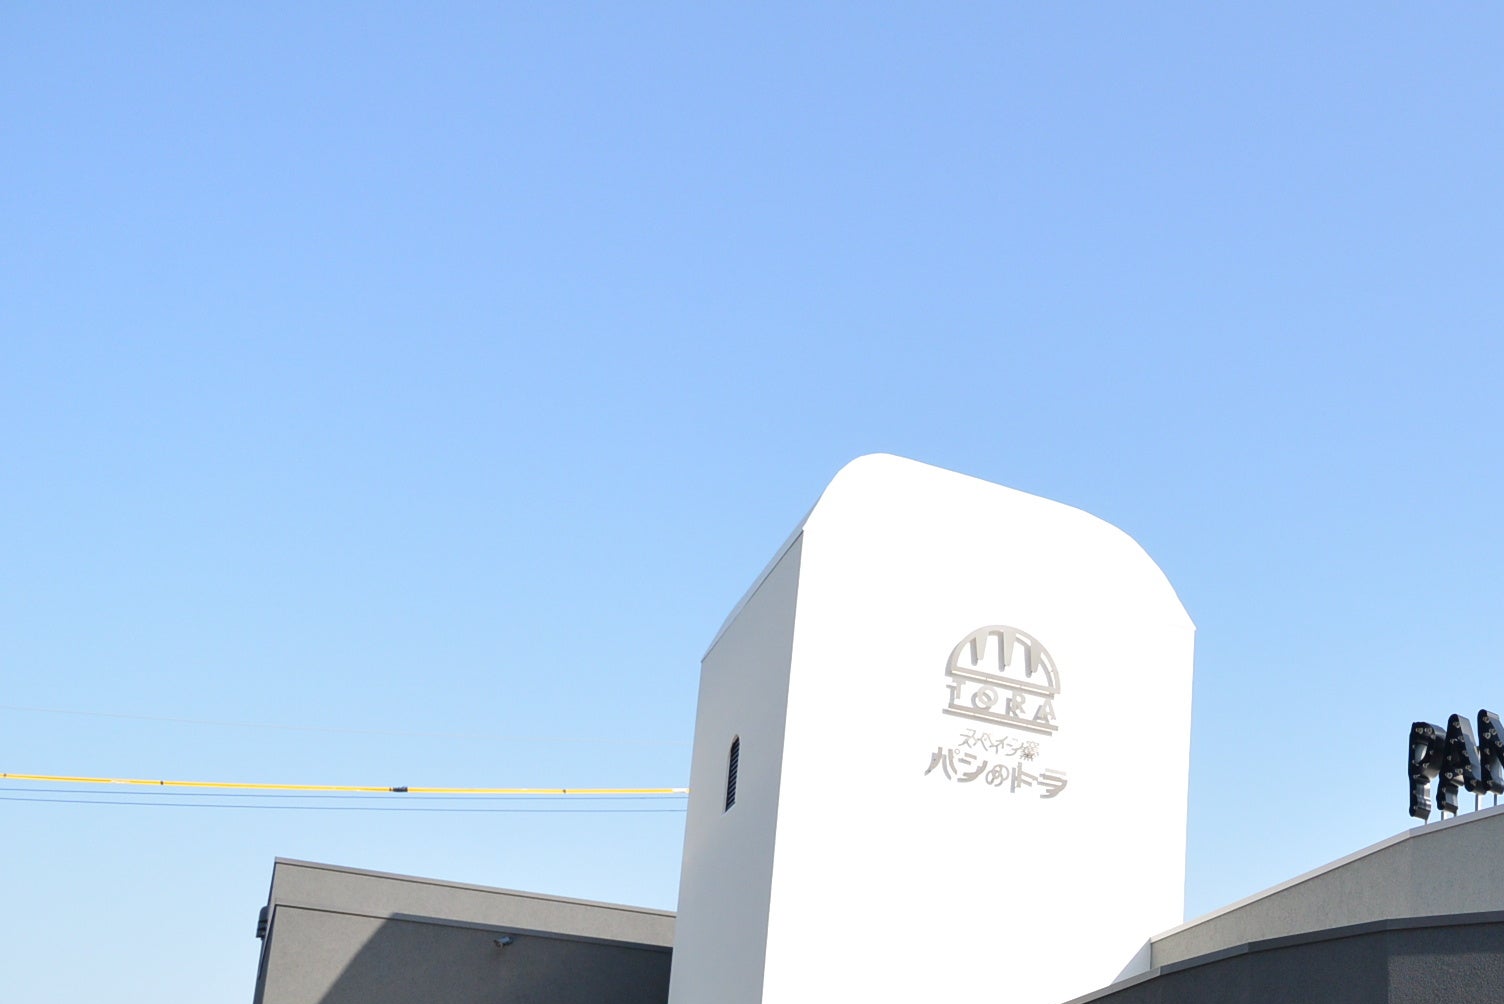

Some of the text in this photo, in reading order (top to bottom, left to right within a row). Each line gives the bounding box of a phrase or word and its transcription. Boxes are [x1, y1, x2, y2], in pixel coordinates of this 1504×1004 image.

[949, 677, 1057, 722] TORA
[925, 746, 1068, 800] パンのトラ
